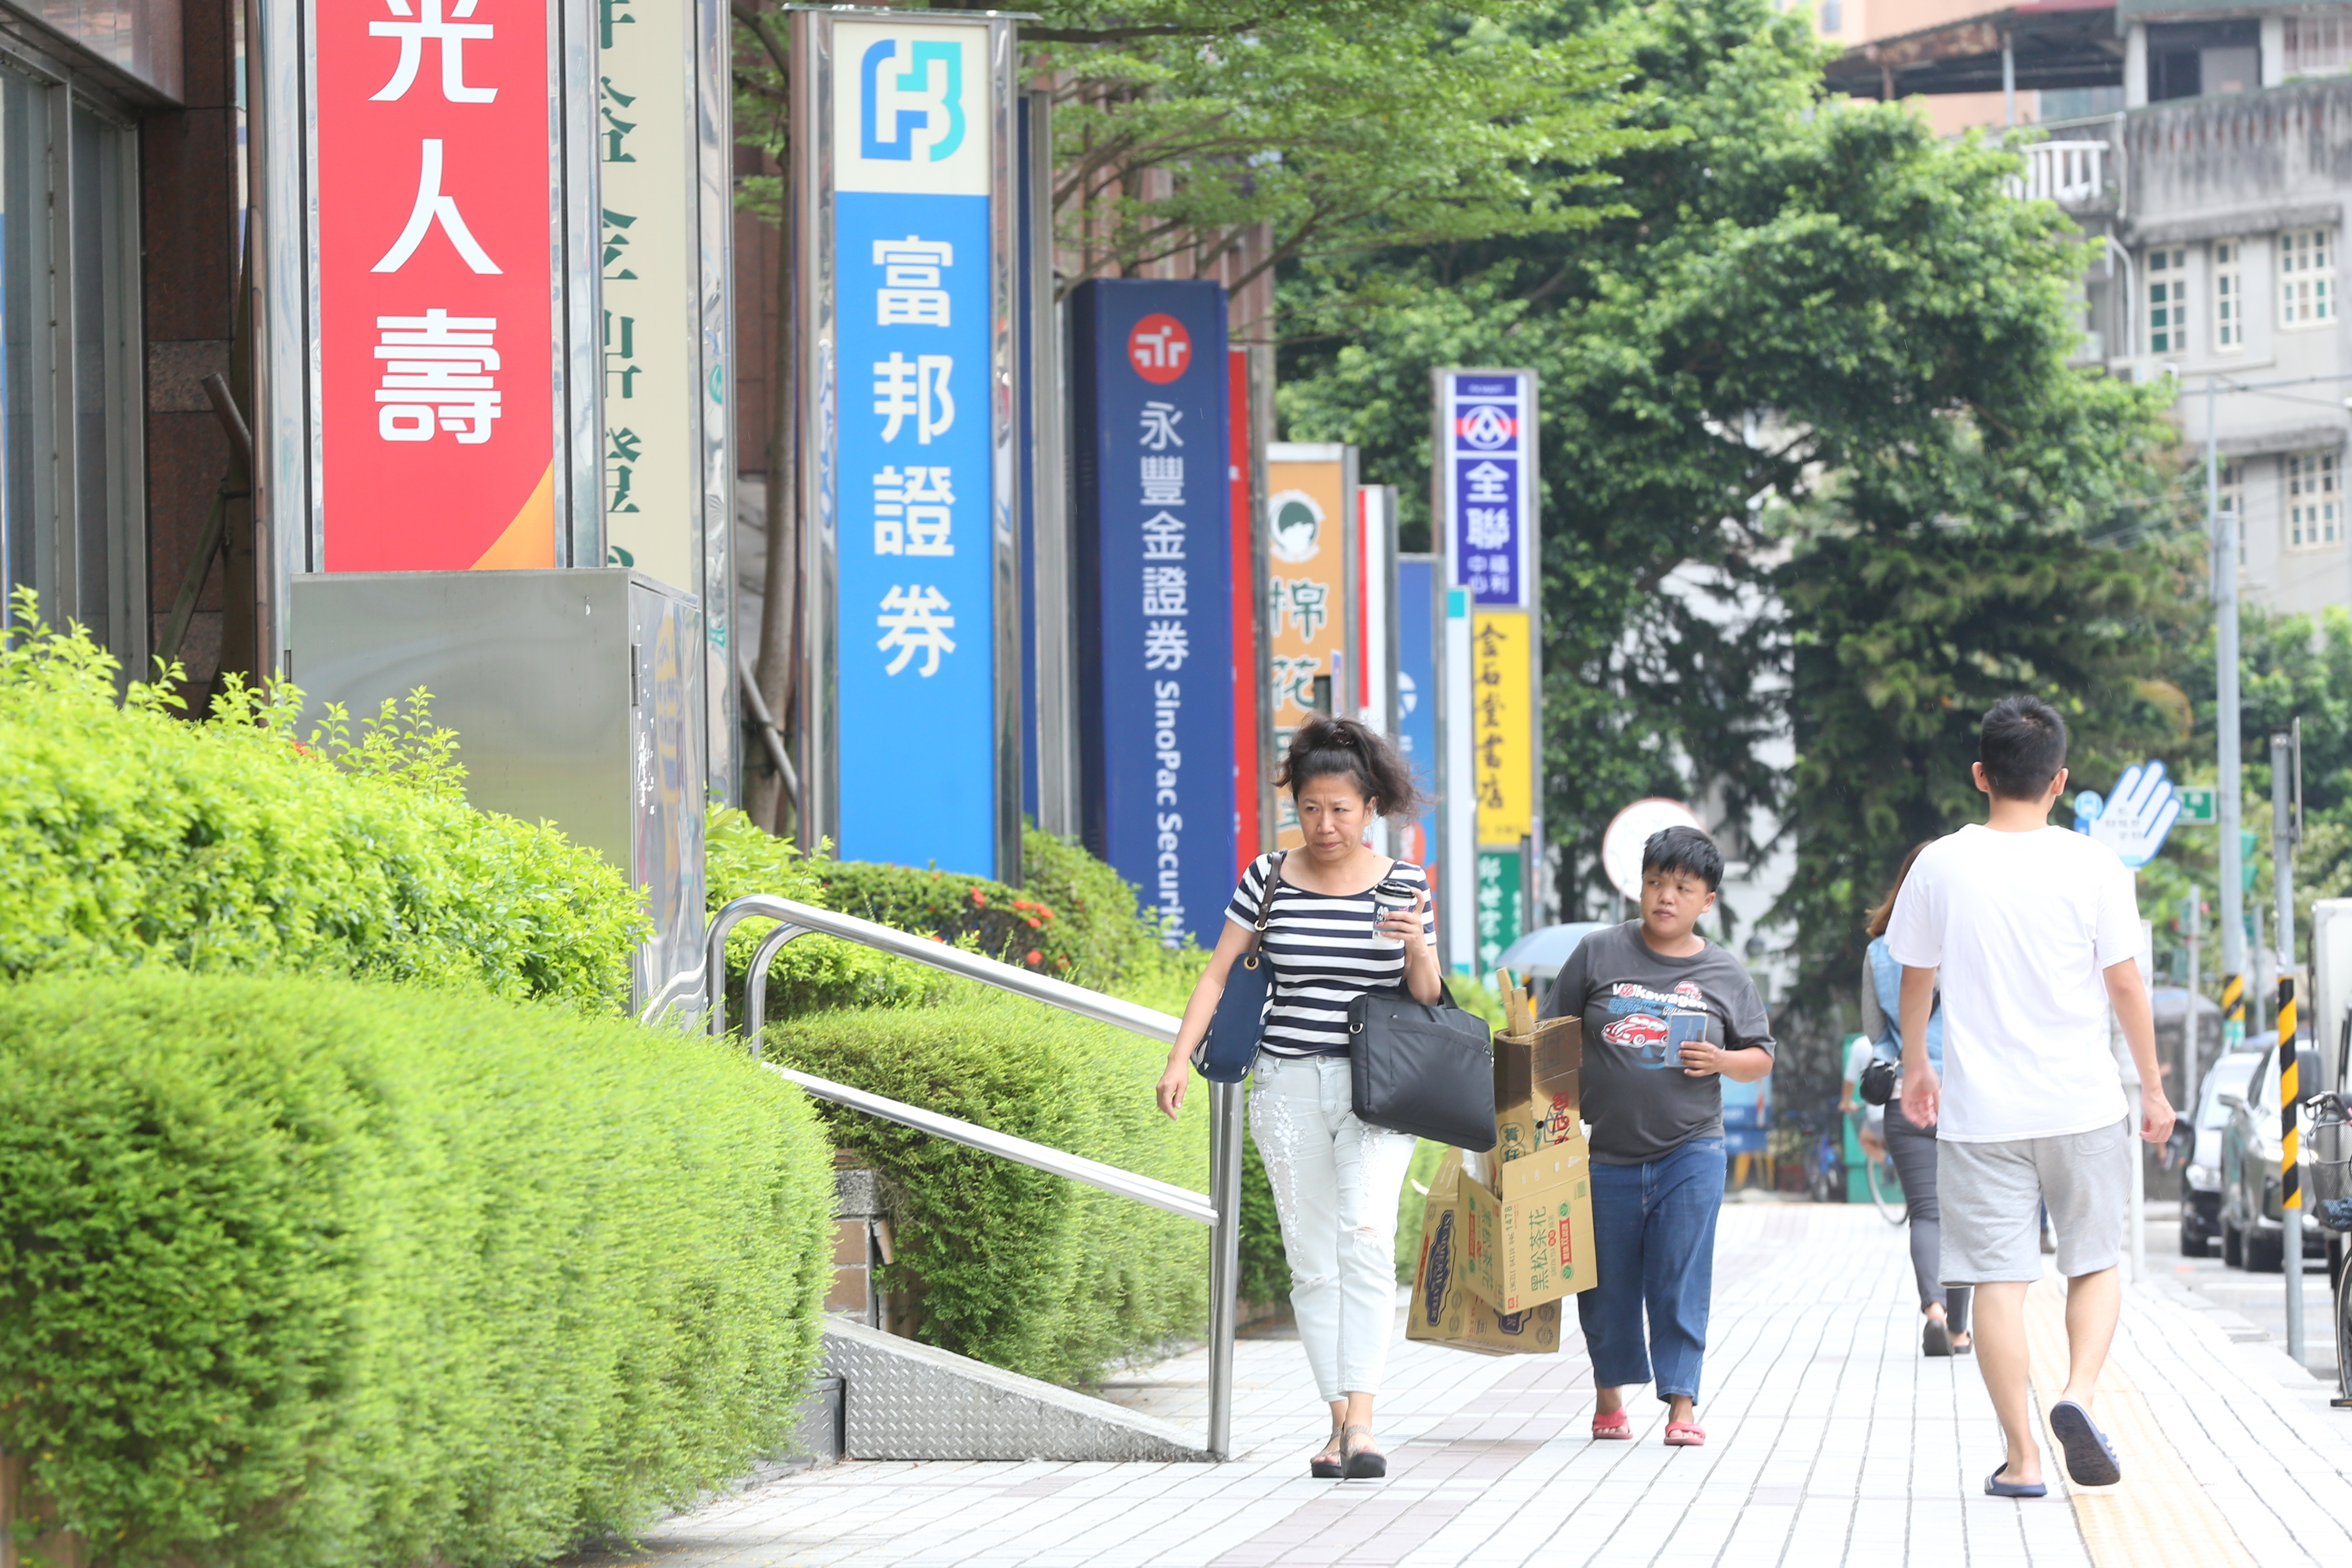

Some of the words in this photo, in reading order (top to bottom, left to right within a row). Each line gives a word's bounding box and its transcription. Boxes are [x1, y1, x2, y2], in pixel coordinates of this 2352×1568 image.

[873, 235, 956, 678] 富邦證券
[1140, 401, 1189, 671] 永豐金證券
[1465, 461, 1510, 550] 全聯
[1154, 679, 1181, 806] SinoPac
[1612, 983, 1707, 1011] Volkswagen
[1504, 1205, 1513, 1231] 1478
[1528, 1206, 1549, 1292] 黑松茶花
